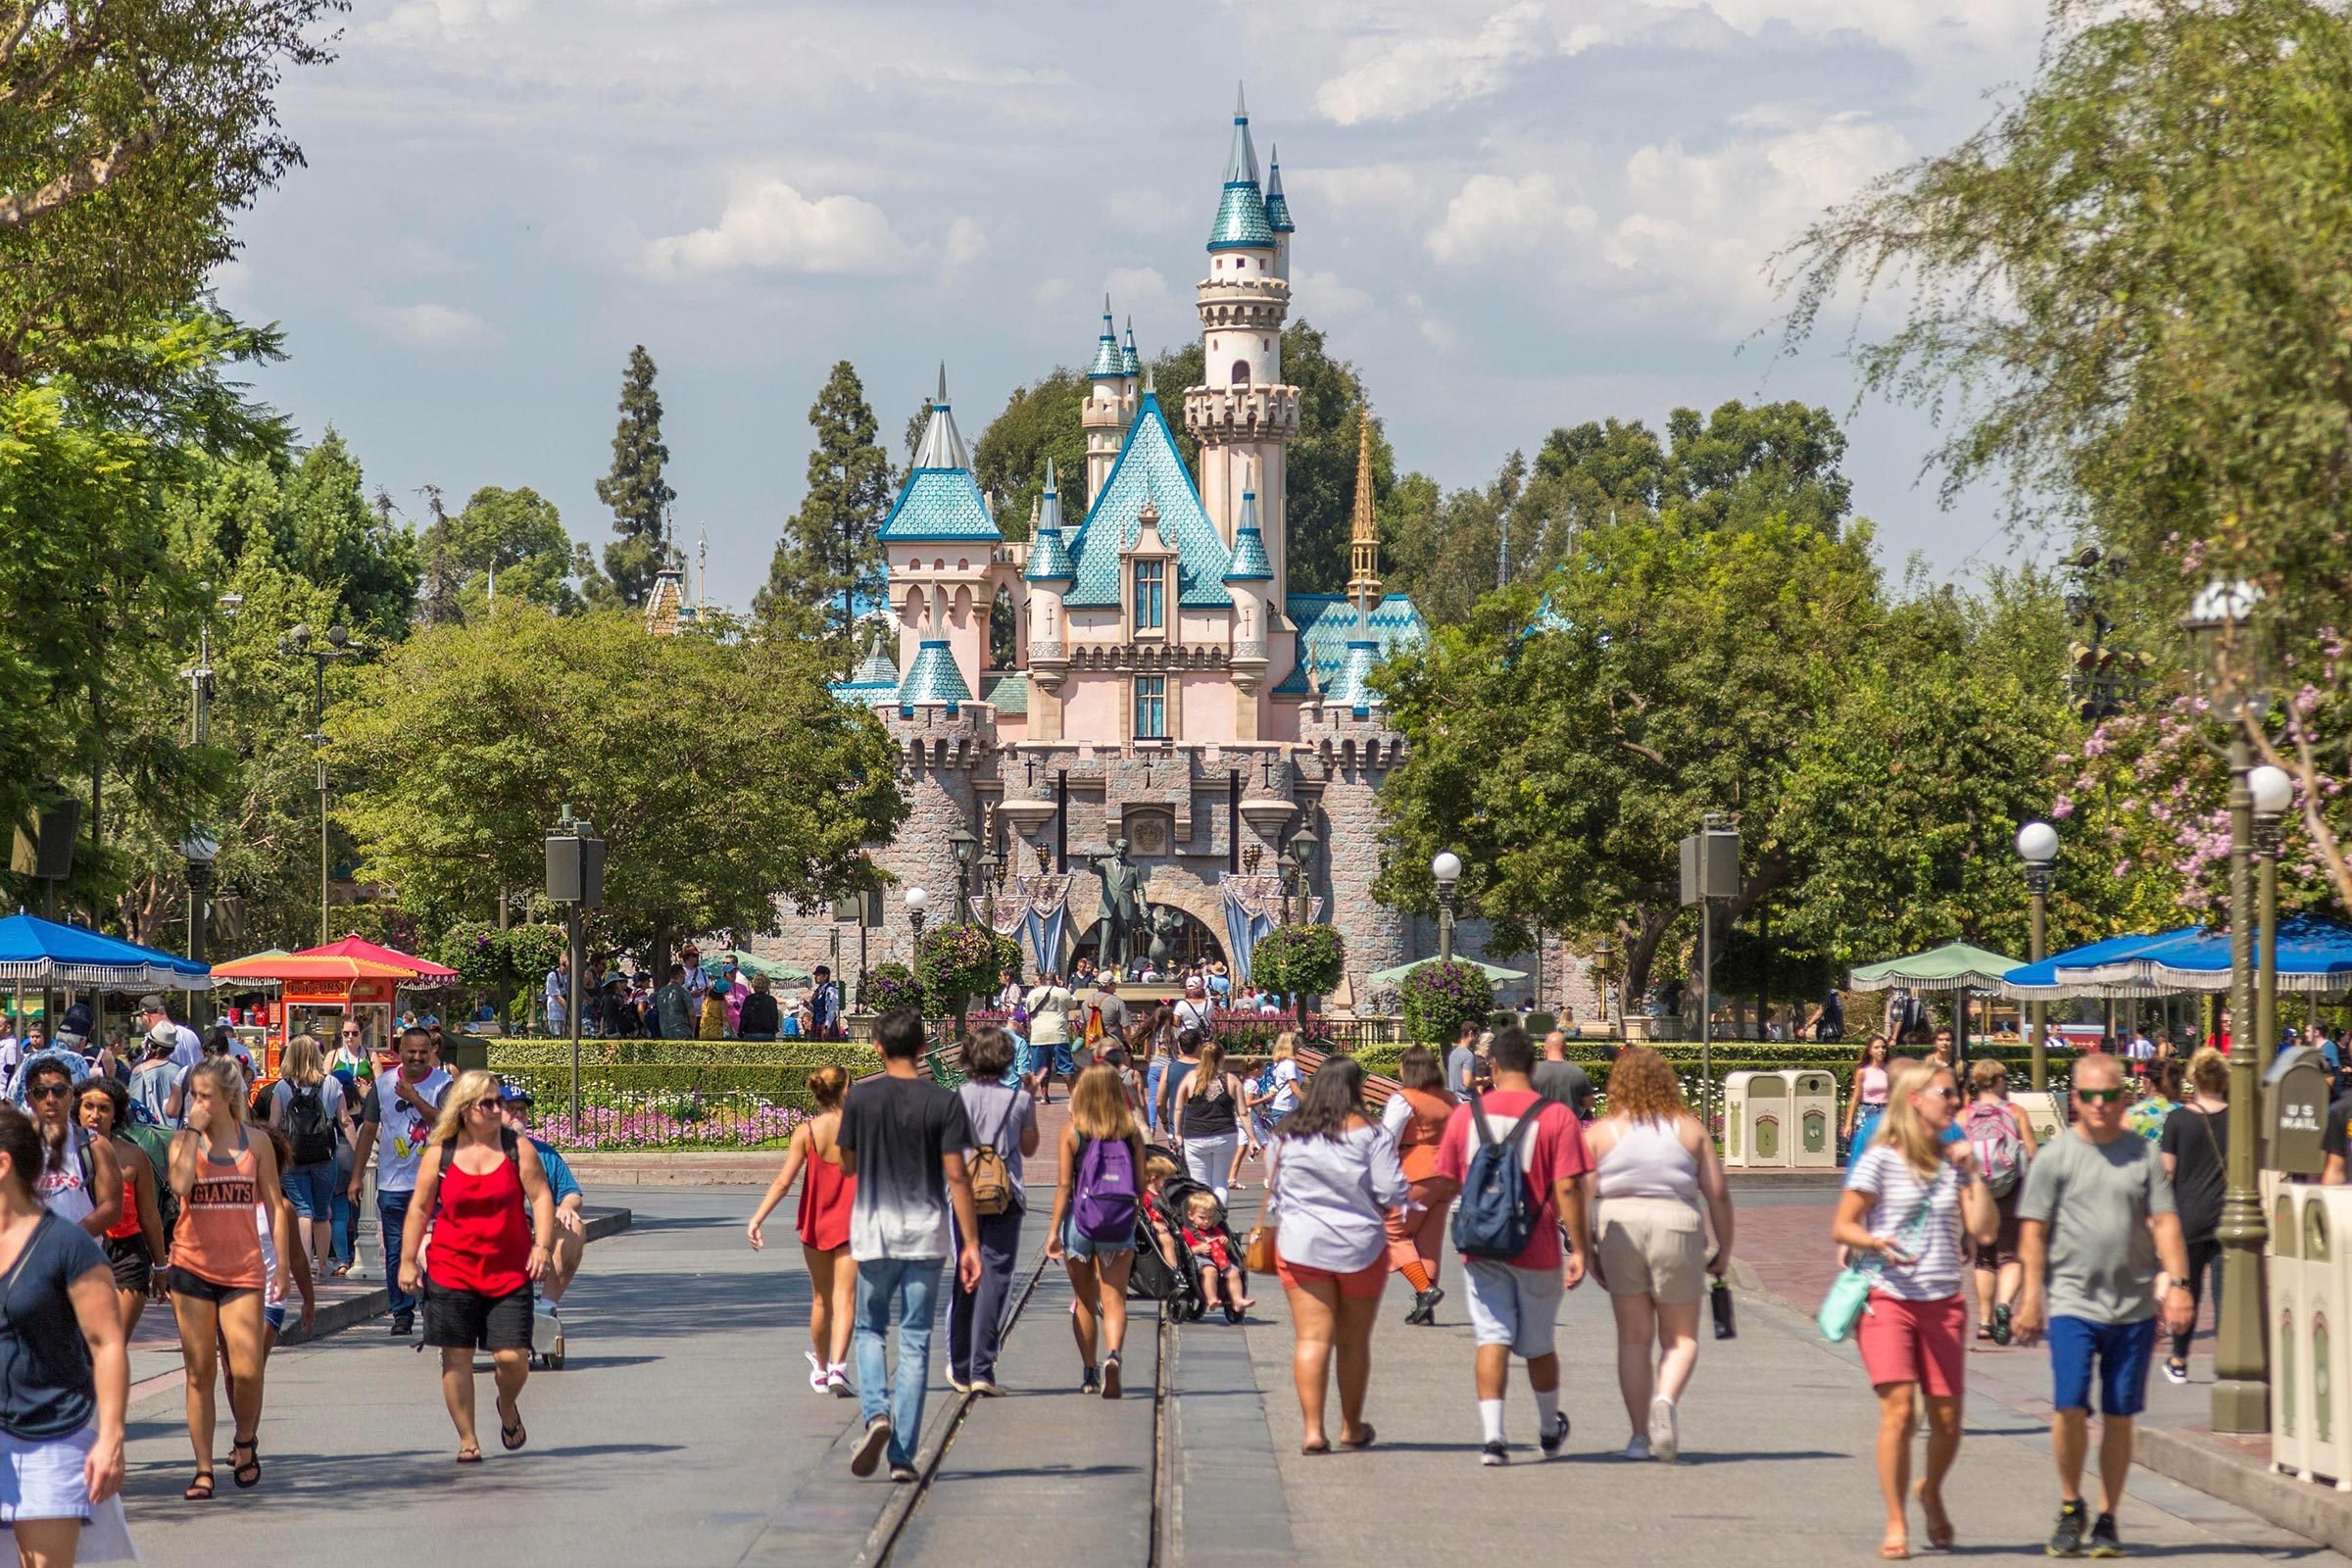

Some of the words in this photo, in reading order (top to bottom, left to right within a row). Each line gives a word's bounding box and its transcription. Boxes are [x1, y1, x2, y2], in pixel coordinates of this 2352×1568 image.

[290, 981, 342, 994] POPCORN
[2279, 1116, 2321, 1132] MAIL
[194, 1183, 252, 1202] GIANTS
